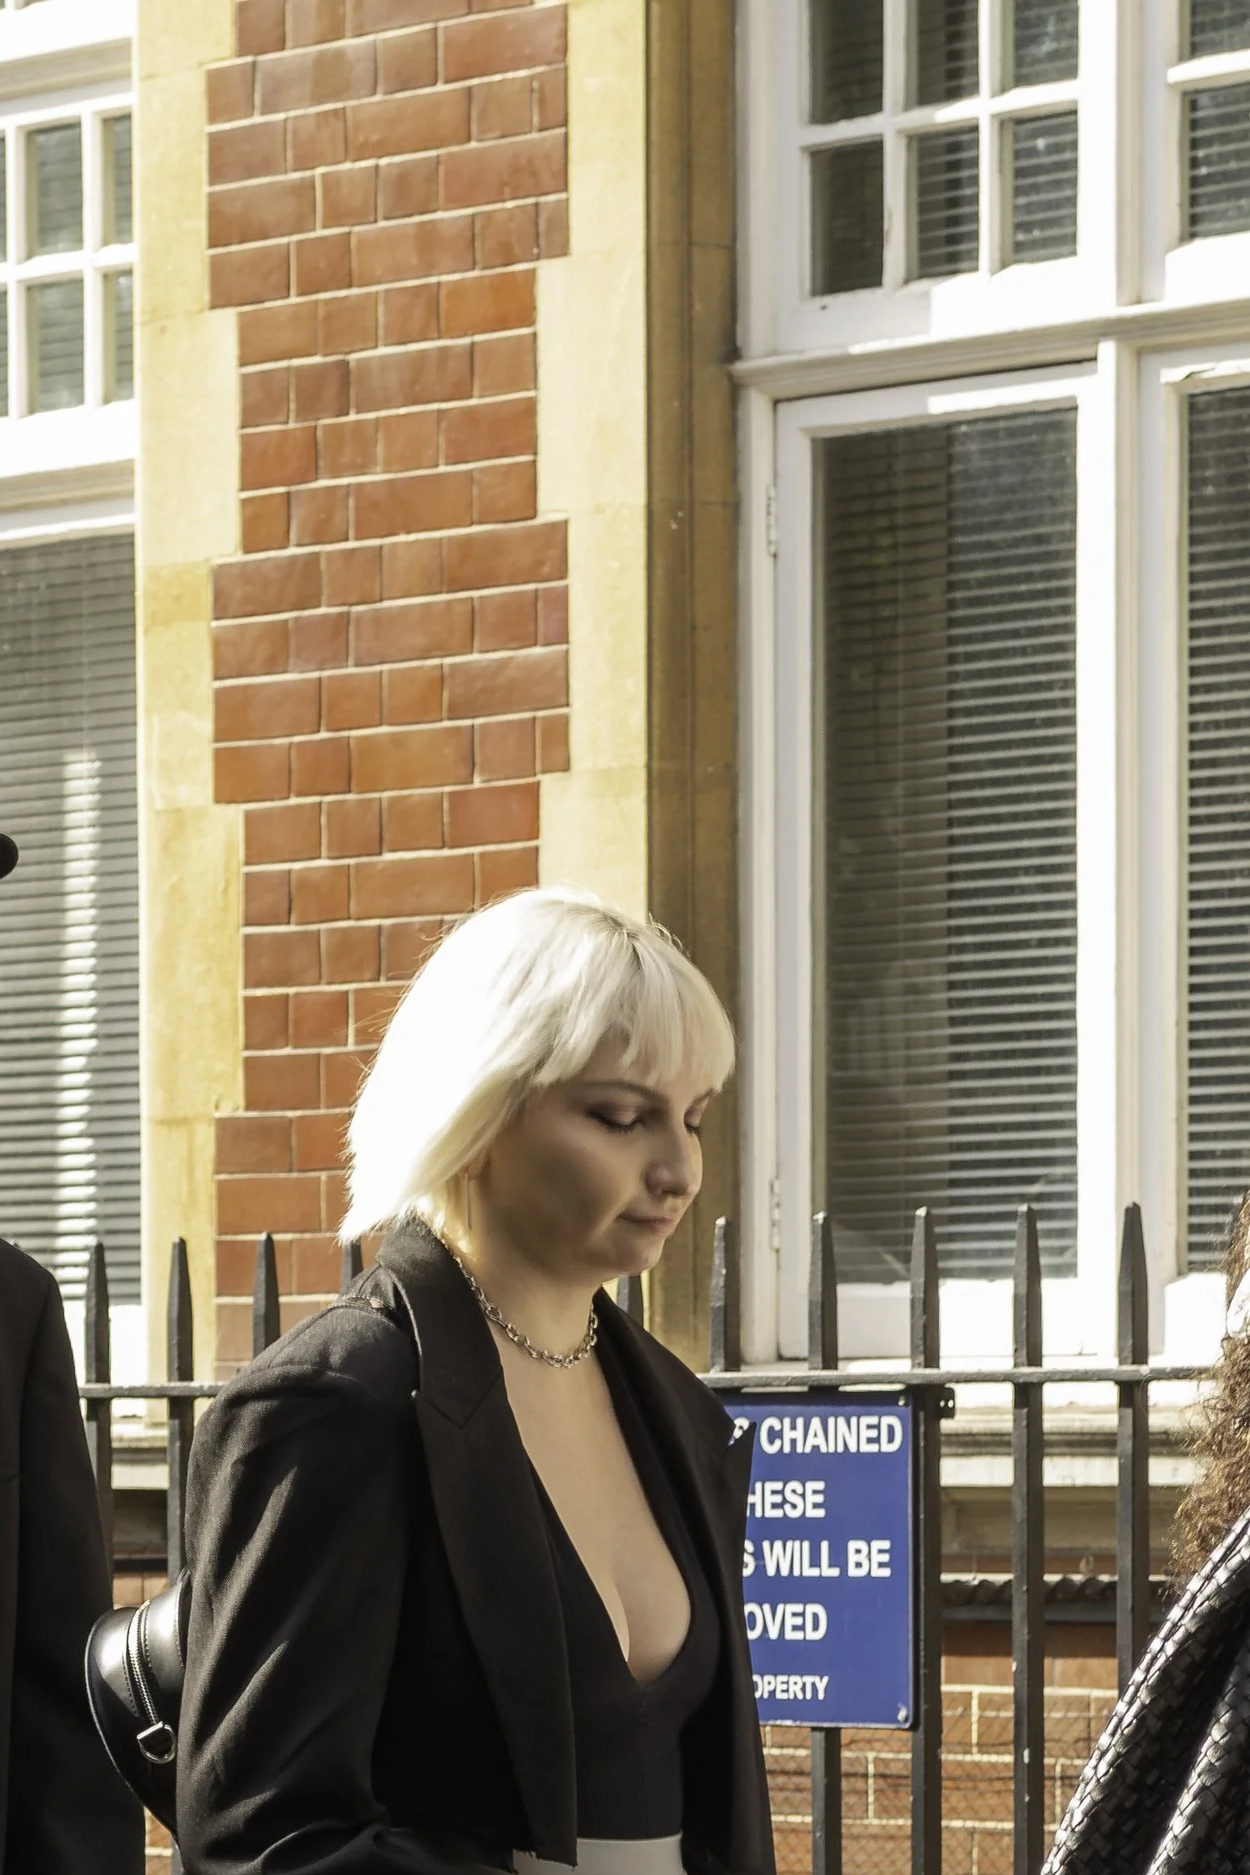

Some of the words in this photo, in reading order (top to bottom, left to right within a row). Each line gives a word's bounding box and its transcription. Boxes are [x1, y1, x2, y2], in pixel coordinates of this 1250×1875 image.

[759, 1416, 903, 1454] CHAINED
[762, 1539, 841, 1577] WILL
[847, 1539, 892, 1578] BE
